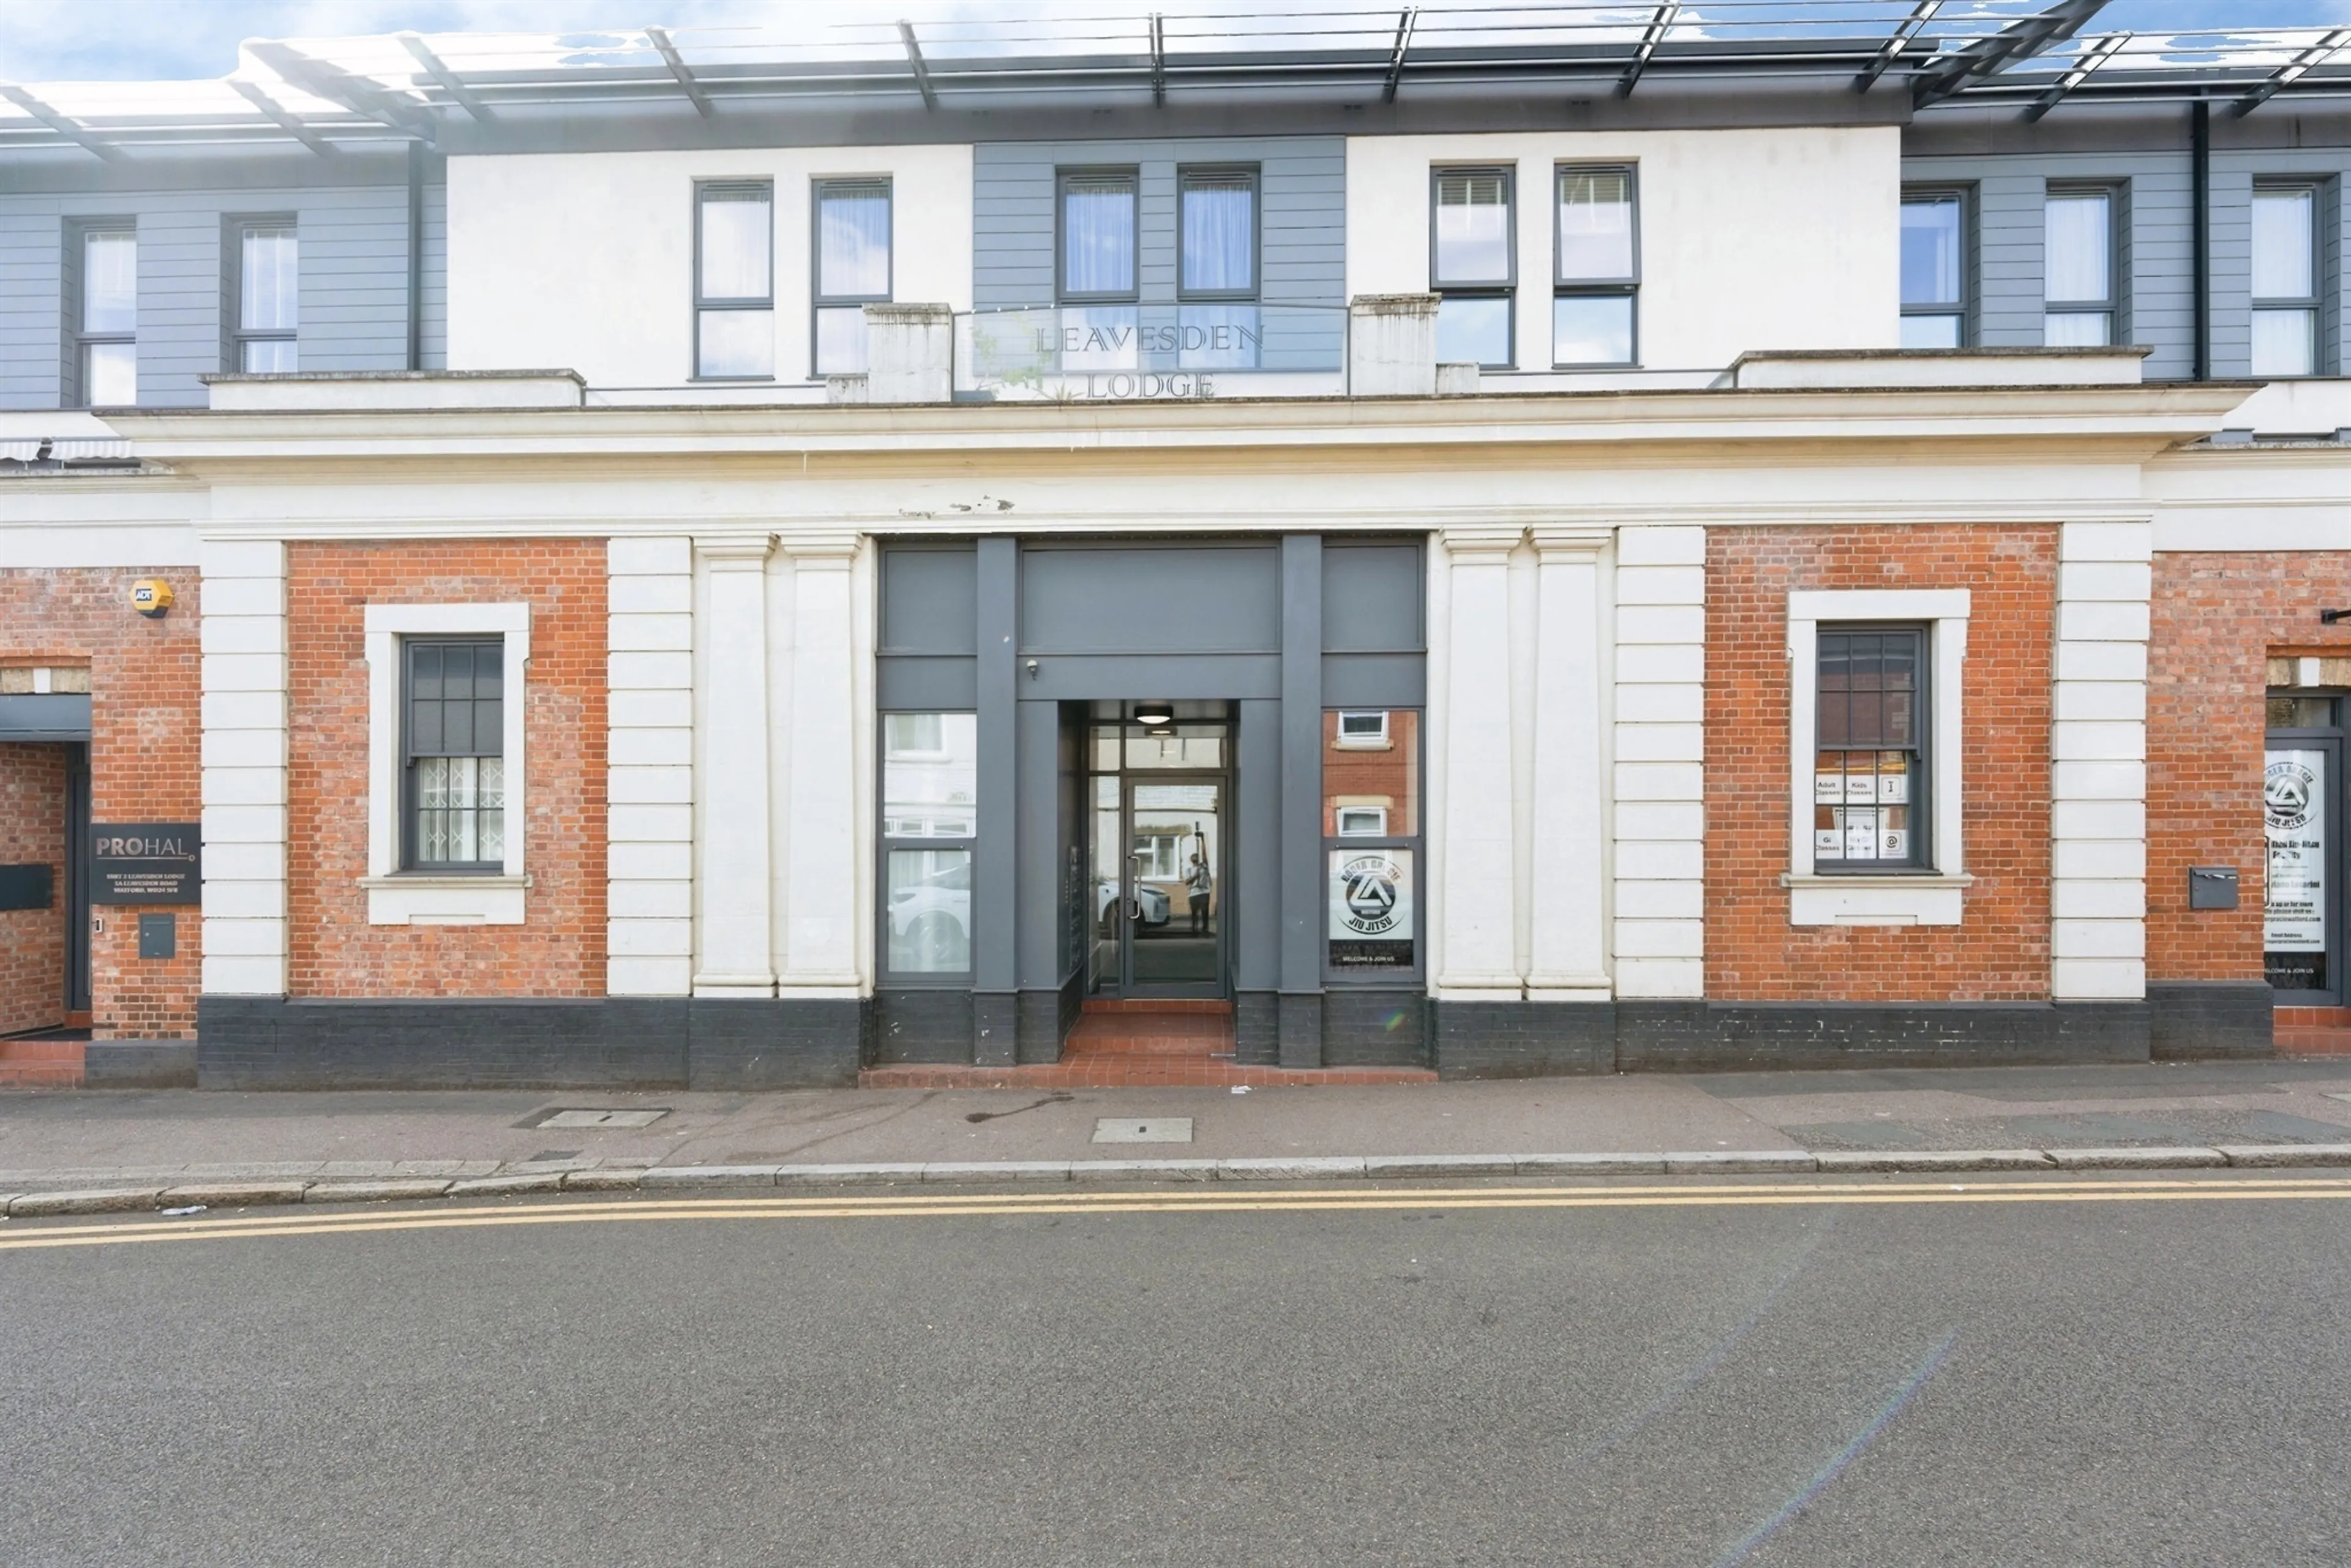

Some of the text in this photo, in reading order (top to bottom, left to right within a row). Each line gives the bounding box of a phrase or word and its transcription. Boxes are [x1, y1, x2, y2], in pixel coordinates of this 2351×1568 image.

[1035, 324, 1265, 353] LEAVESDEN
[1086, 372, 1214, 399] LODGE
[96, 838, 188, 855] PROHAL
[1371, 860, 1400, 882] GRCIE
[1349, 916, 1392, 931] JIU JITSU
